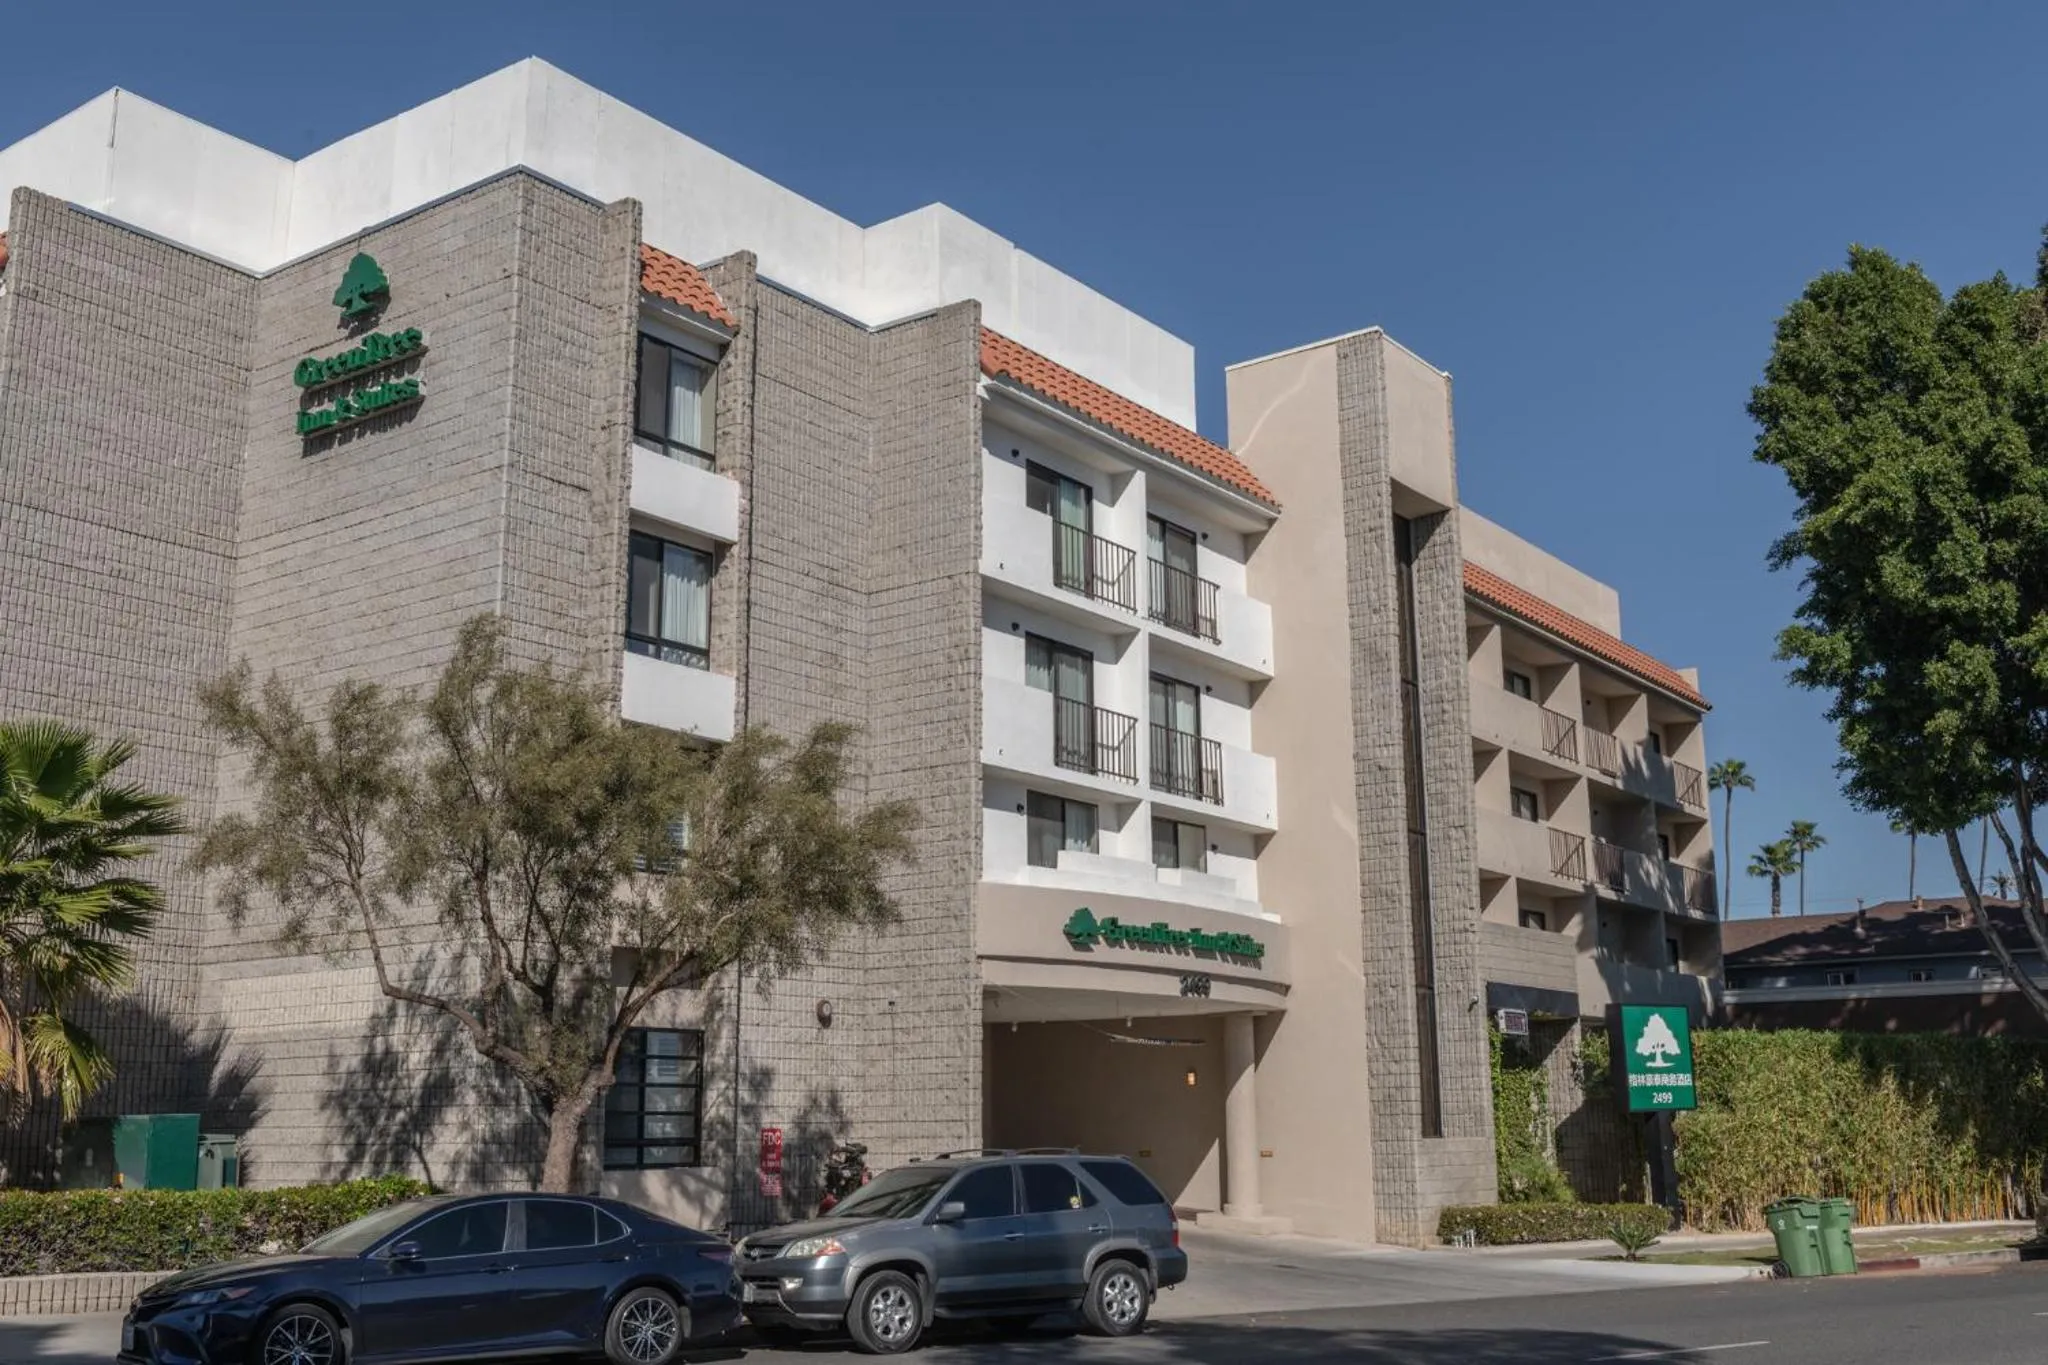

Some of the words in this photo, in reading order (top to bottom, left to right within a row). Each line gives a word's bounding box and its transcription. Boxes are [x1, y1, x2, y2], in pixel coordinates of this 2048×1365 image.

[294, 327, 423, 387] GreenTree
[296, 409, 337, 435] Inn
[354, 379, 420, 414] Suites
[1652, 1092, 1673, 1104] 2499
[762, 1131, 781, 1145] FDC
